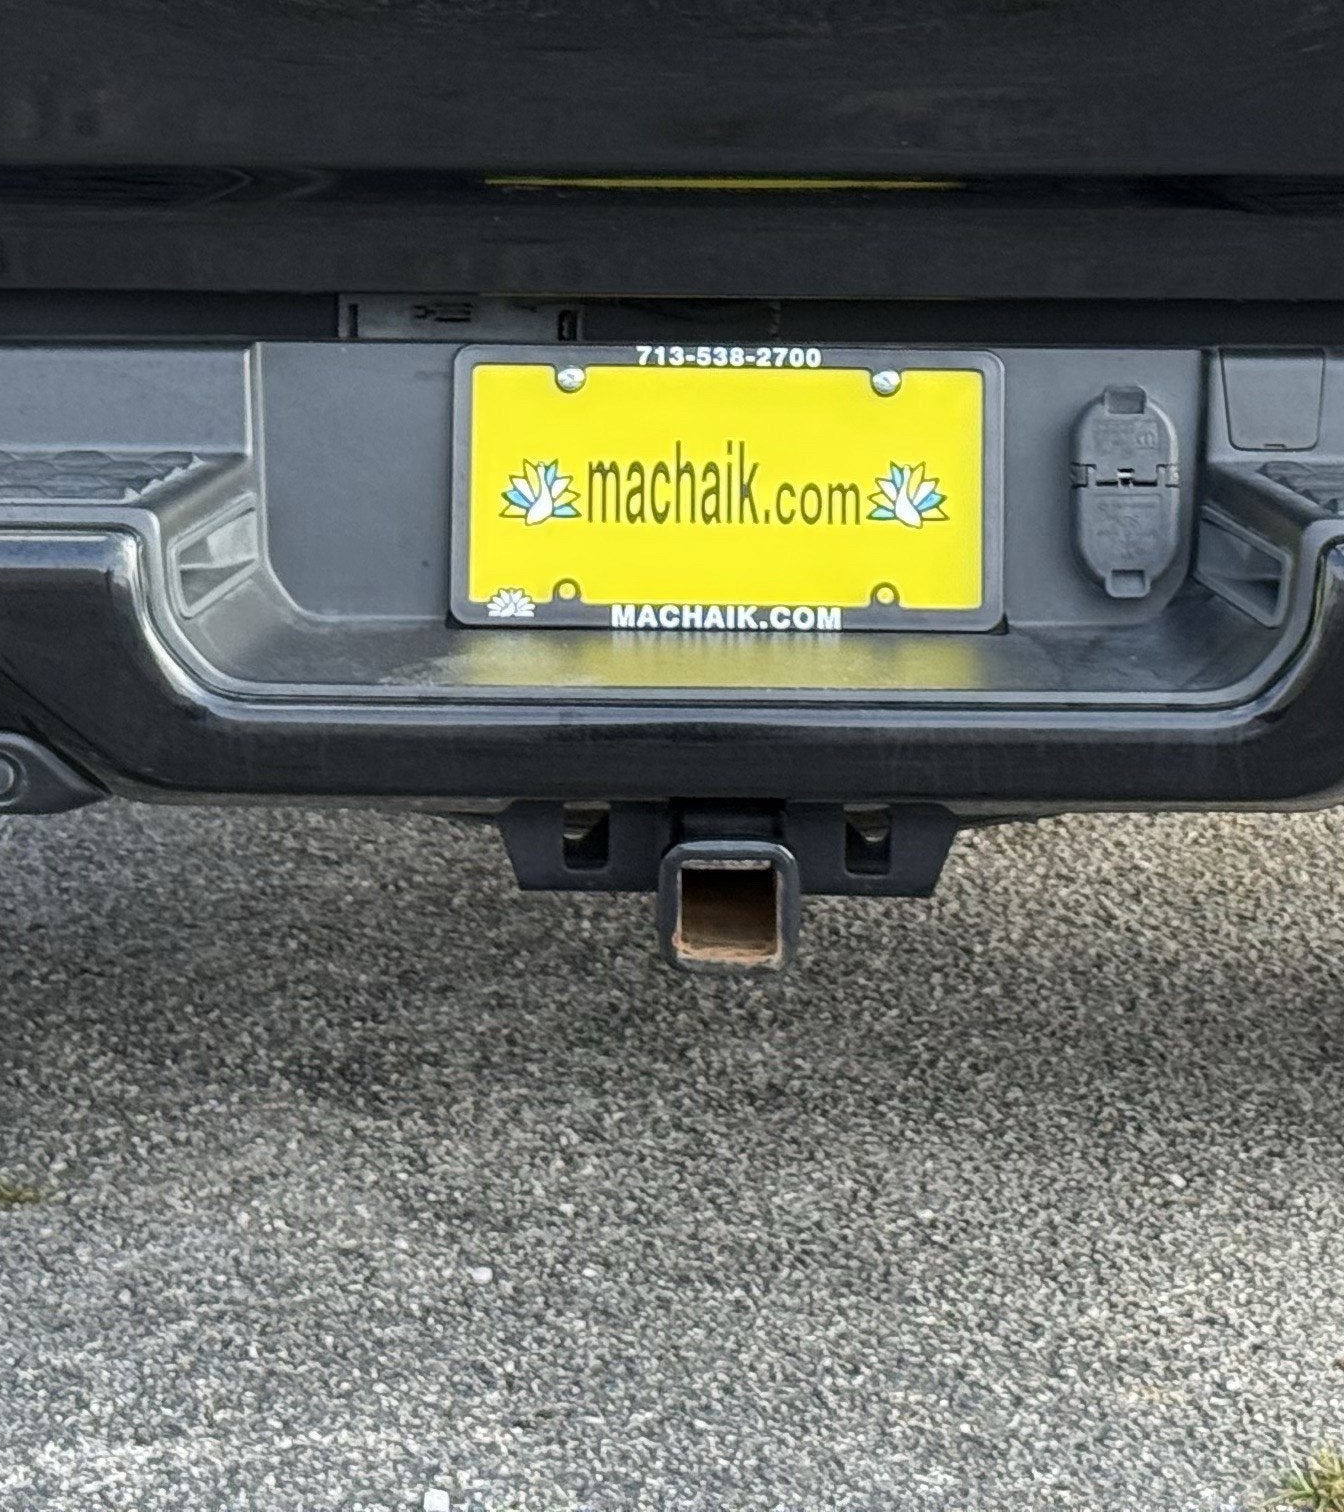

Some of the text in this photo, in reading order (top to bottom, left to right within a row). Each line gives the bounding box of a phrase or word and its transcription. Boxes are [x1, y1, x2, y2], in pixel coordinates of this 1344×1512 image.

[635, 345, 822, 368] 713-538-2700
[587, 439, 861, 525] machaik.com
[610, 603, 843, 631] MACHAIK.COM
